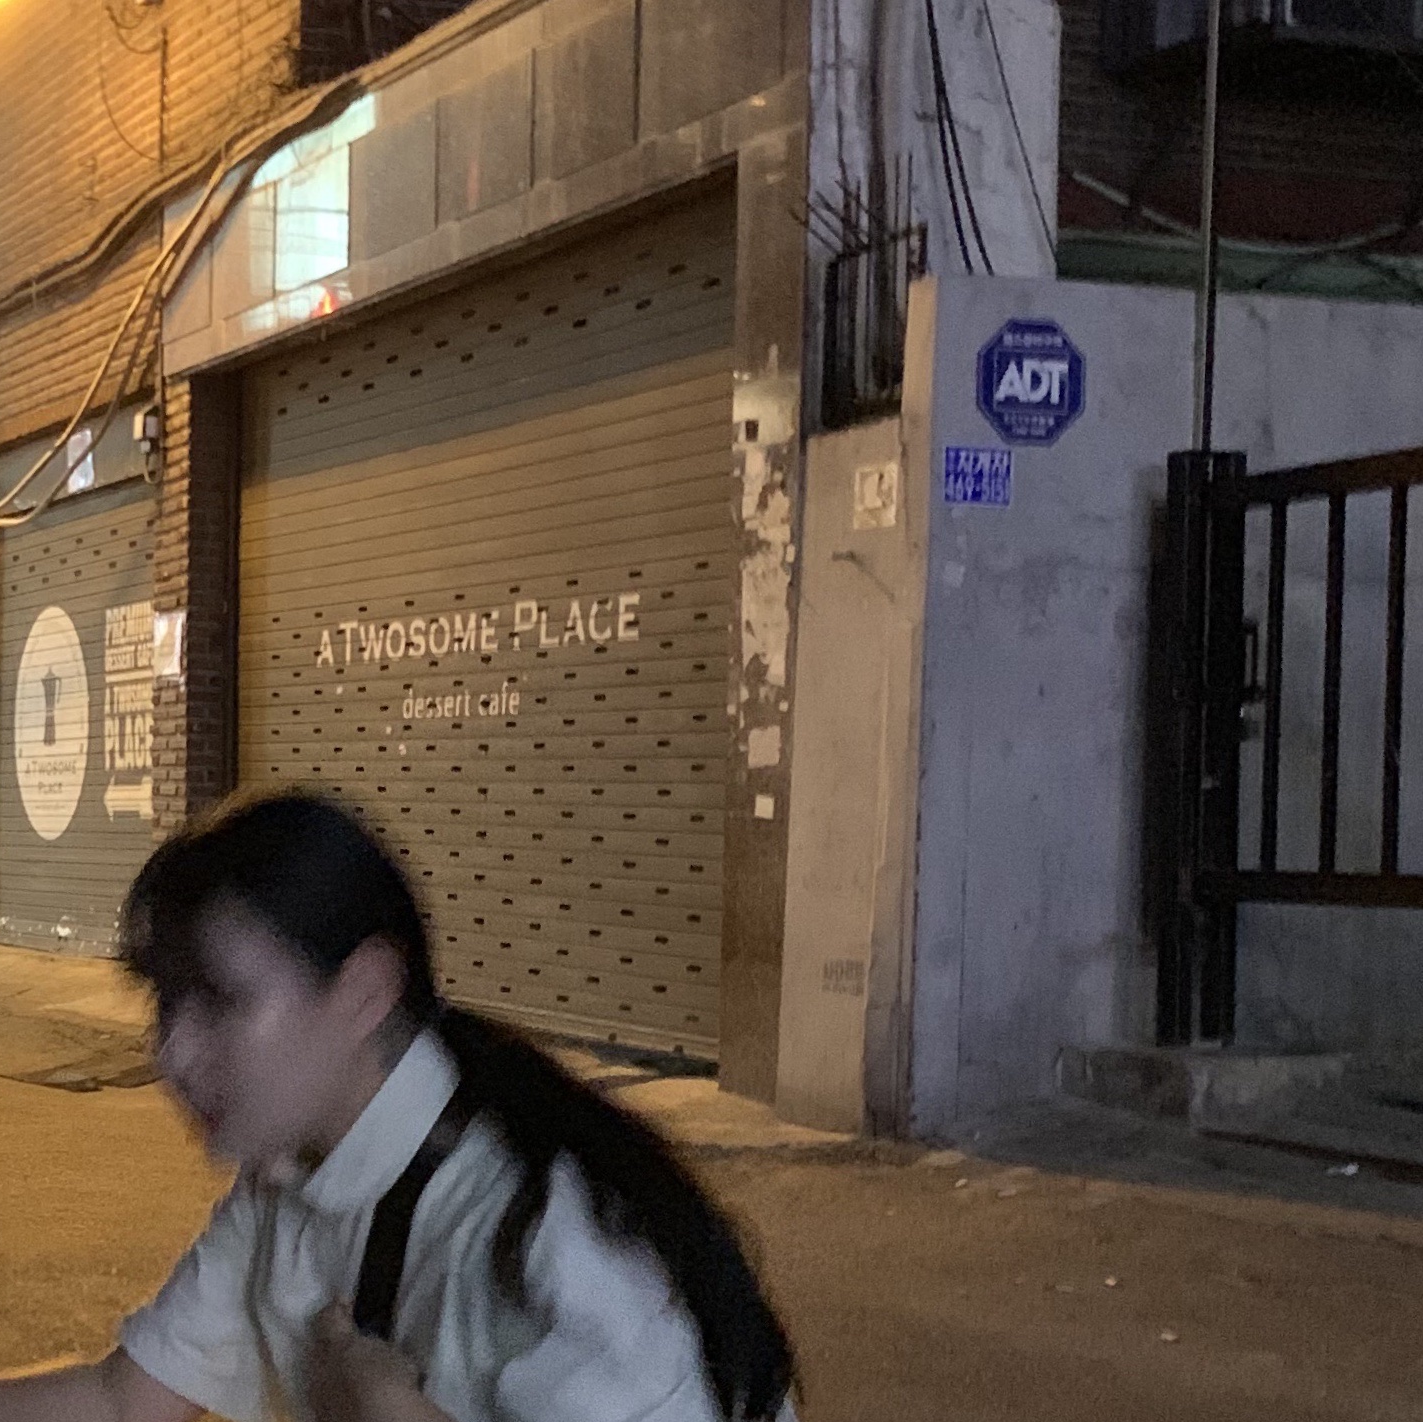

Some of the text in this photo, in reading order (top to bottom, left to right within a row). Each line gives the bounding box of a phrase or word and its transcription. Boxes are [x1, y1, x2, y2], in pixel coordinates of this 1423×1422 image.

[994, 359, 1068, 405] ADT
[513, 592, 640, 650] PLACE
[403, 681, 520, 718] dessert cafe
[105, 714, 154, 770] PLACE
